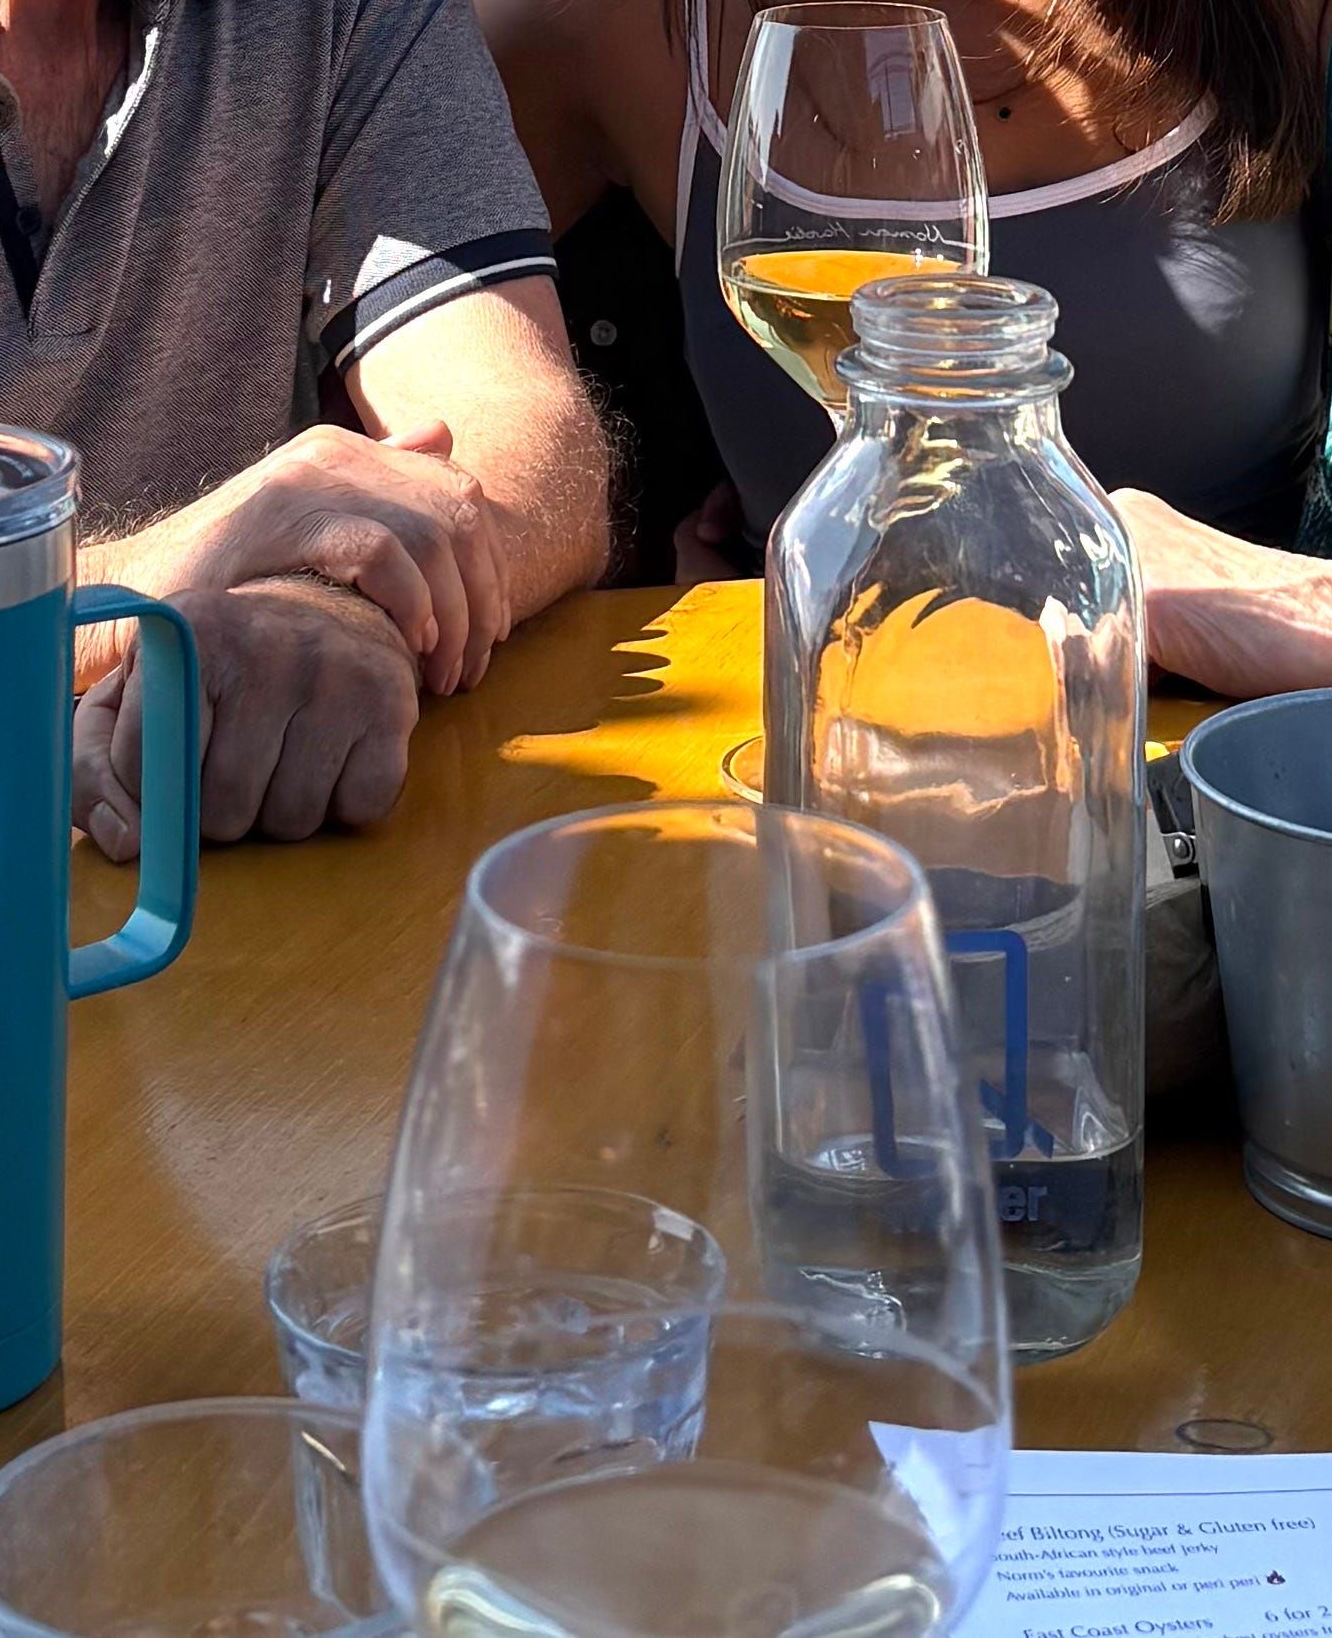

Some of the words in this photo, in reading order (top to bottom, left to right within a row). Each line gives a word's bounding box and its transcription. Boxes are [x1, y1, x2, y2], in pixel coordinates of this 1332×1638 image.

[1030, 1525, 1104, 1543] Biltong
[1108, 1523, 1169, 1542] (Sugar
[1177, 1523, 1193, 1536] &
[1198, 1520, 1267, 1535] Gluten
[1271, 1517, 1316, 1531] free)
[1102, 1546, 1139, 1559] style
[1142, 1544, 1176, 1555] beef
[1181, 1542, 1219, 1557] jerky
[996, 1569, 1055, 1582] Norm's
[1058, 1566, 1128, 1579] favourite
[1133, 1562, 1180, 1574] snack
[1006, 1586, 1081, 1602] Available
[1085, 1584, 1102, 1597] in
[1105, 1581, 1169, 1597] original
[1171, 1581, 1189, 1592] or
[1193, 1578, 1225, 1592] peri
[1229, 1576, 1261, 1590] peri
[1264, 1610, 1279, 1623] 6
[1283, 1607, 1312, 1620] for
[1022, 1627, 1065, 1638] East
[1070, 1623, 1131, 1638] Coast
[1135, 1617, 1214, 1636] Oysters
